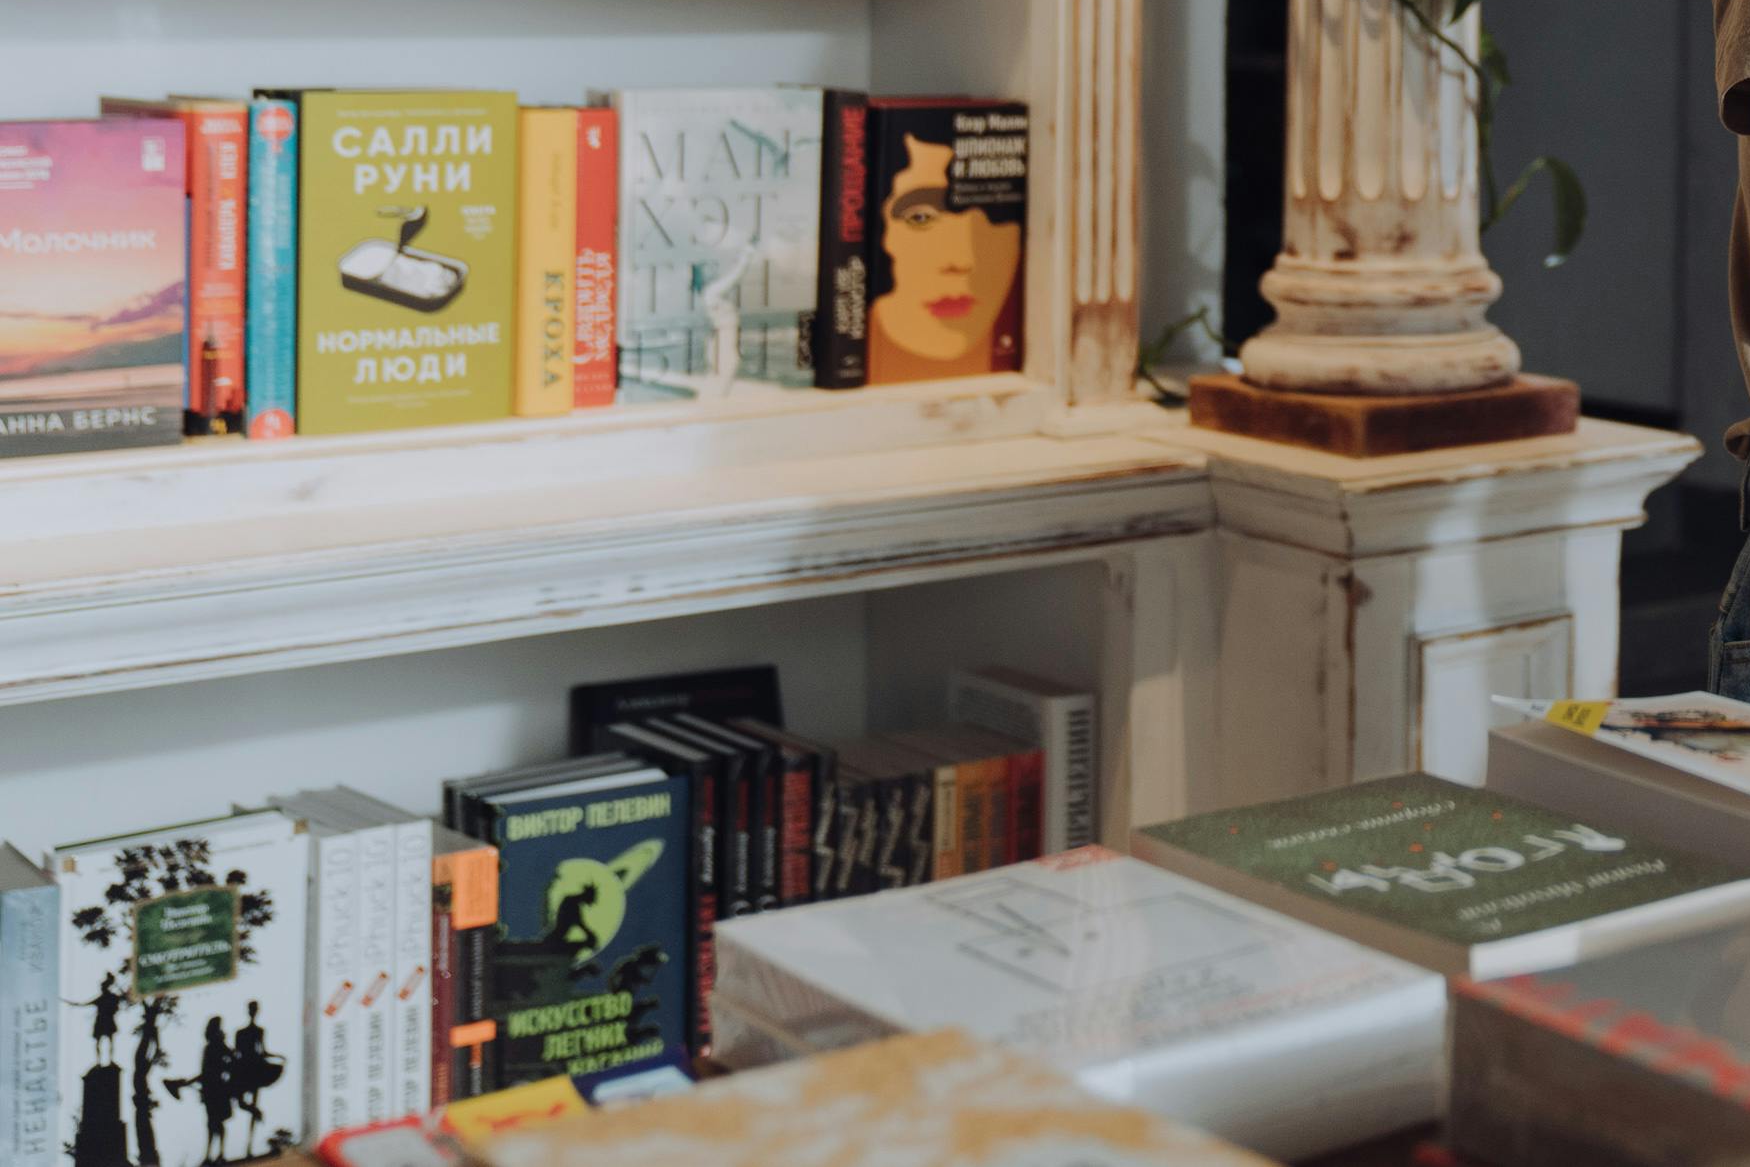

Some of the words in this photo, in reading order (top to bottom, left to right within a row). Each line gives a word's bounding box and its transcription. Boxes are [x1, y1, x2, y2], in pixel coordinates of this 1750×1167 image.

[331, 124, 493, 158] САЛЛИ
[353, 161, 472, 195] РУНИ
[316, 321, 501, 355] НОРМАЛЬНЫЕ
[543, 271, 566, 389] КРОХА
[353, 352, 468, 385] ЛЮДИ
[72, 406, 158, 431] БЕРНС
[507, 805, 584, 842] ВИКТОР
[586, 792, 672, 830] ПЕЛЕВИН
[506, 991, 634, 1039] ИСКУССТВО
[24, 997, 49, 1156] НЕНАСТЬЕ
